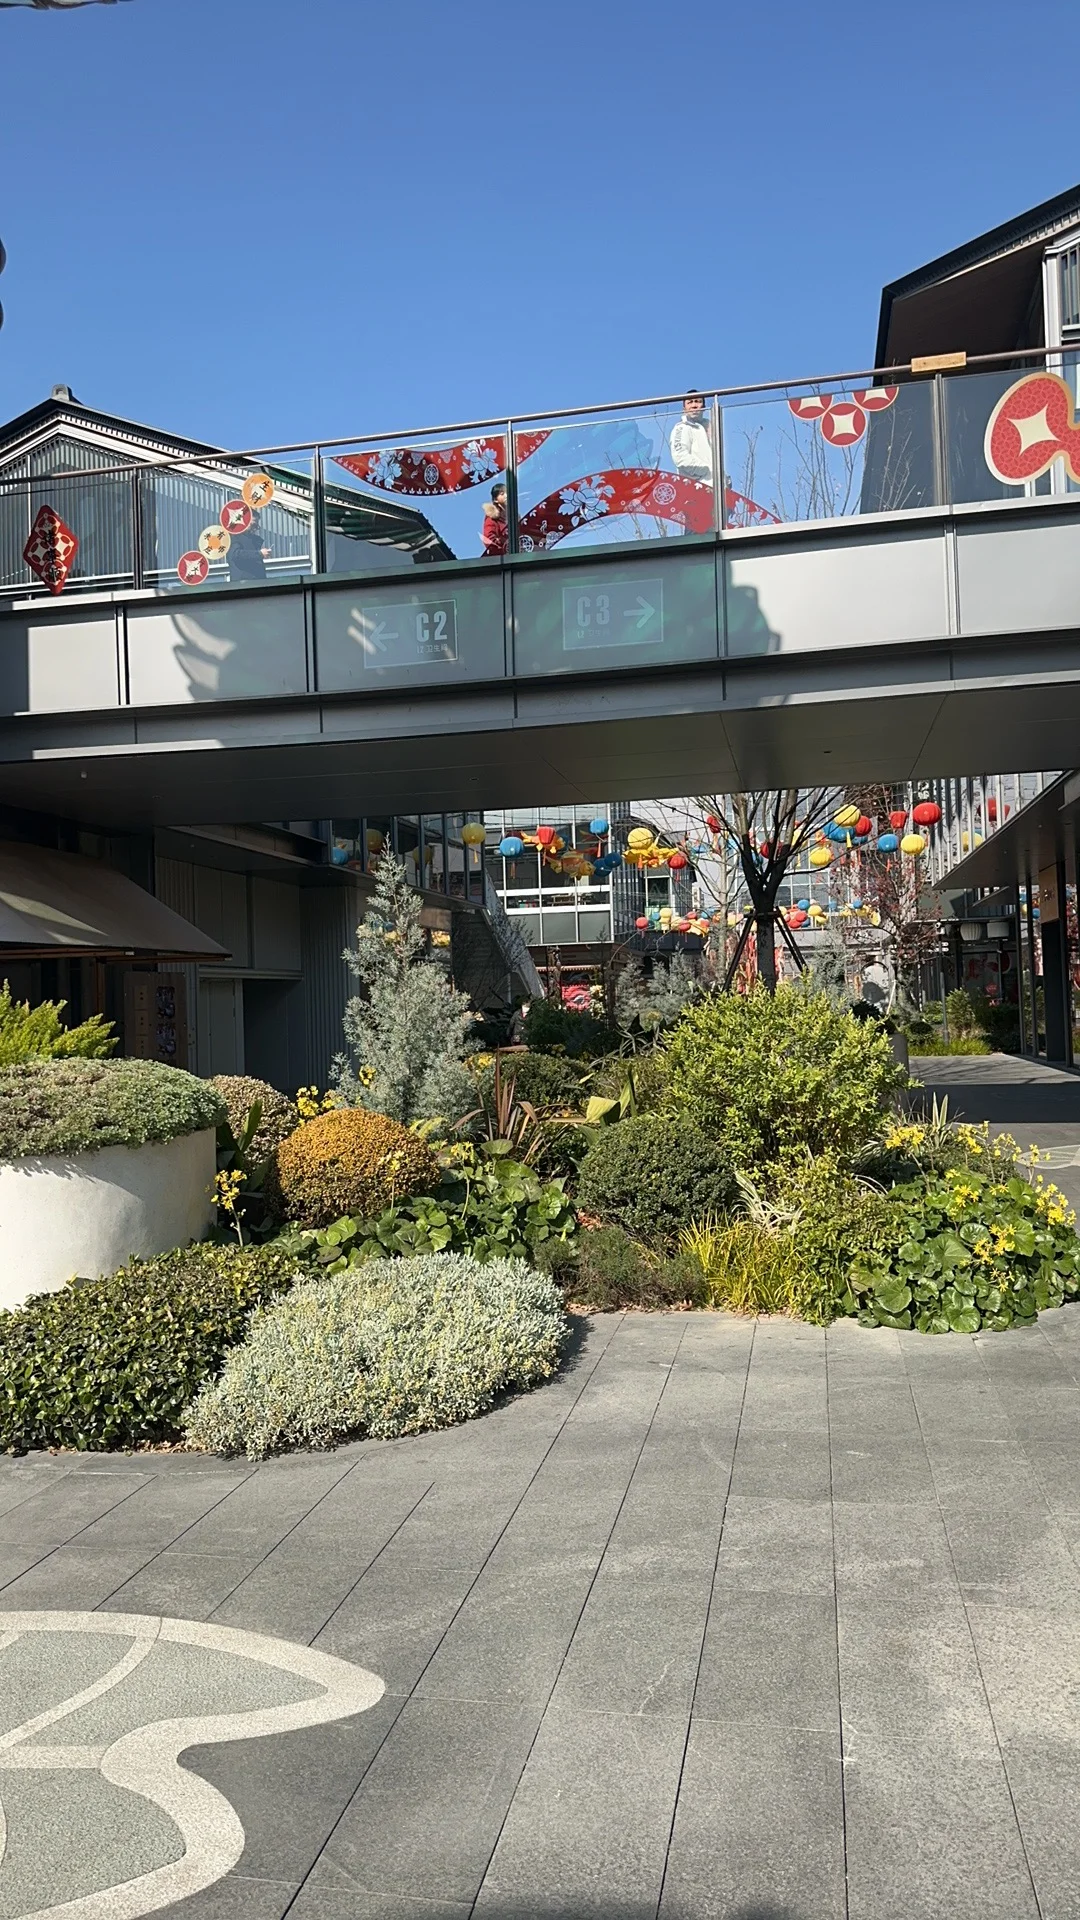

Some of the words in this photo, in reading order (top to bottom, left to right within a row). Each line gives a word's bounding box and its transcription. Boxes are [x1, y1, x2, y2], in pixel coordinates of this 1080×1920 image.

[251, 480, 270, 504] 生财
[577, 594, 610, 627] C3
[416, 610, 448, 642] C2
[577, 630, 584, 639] L2
